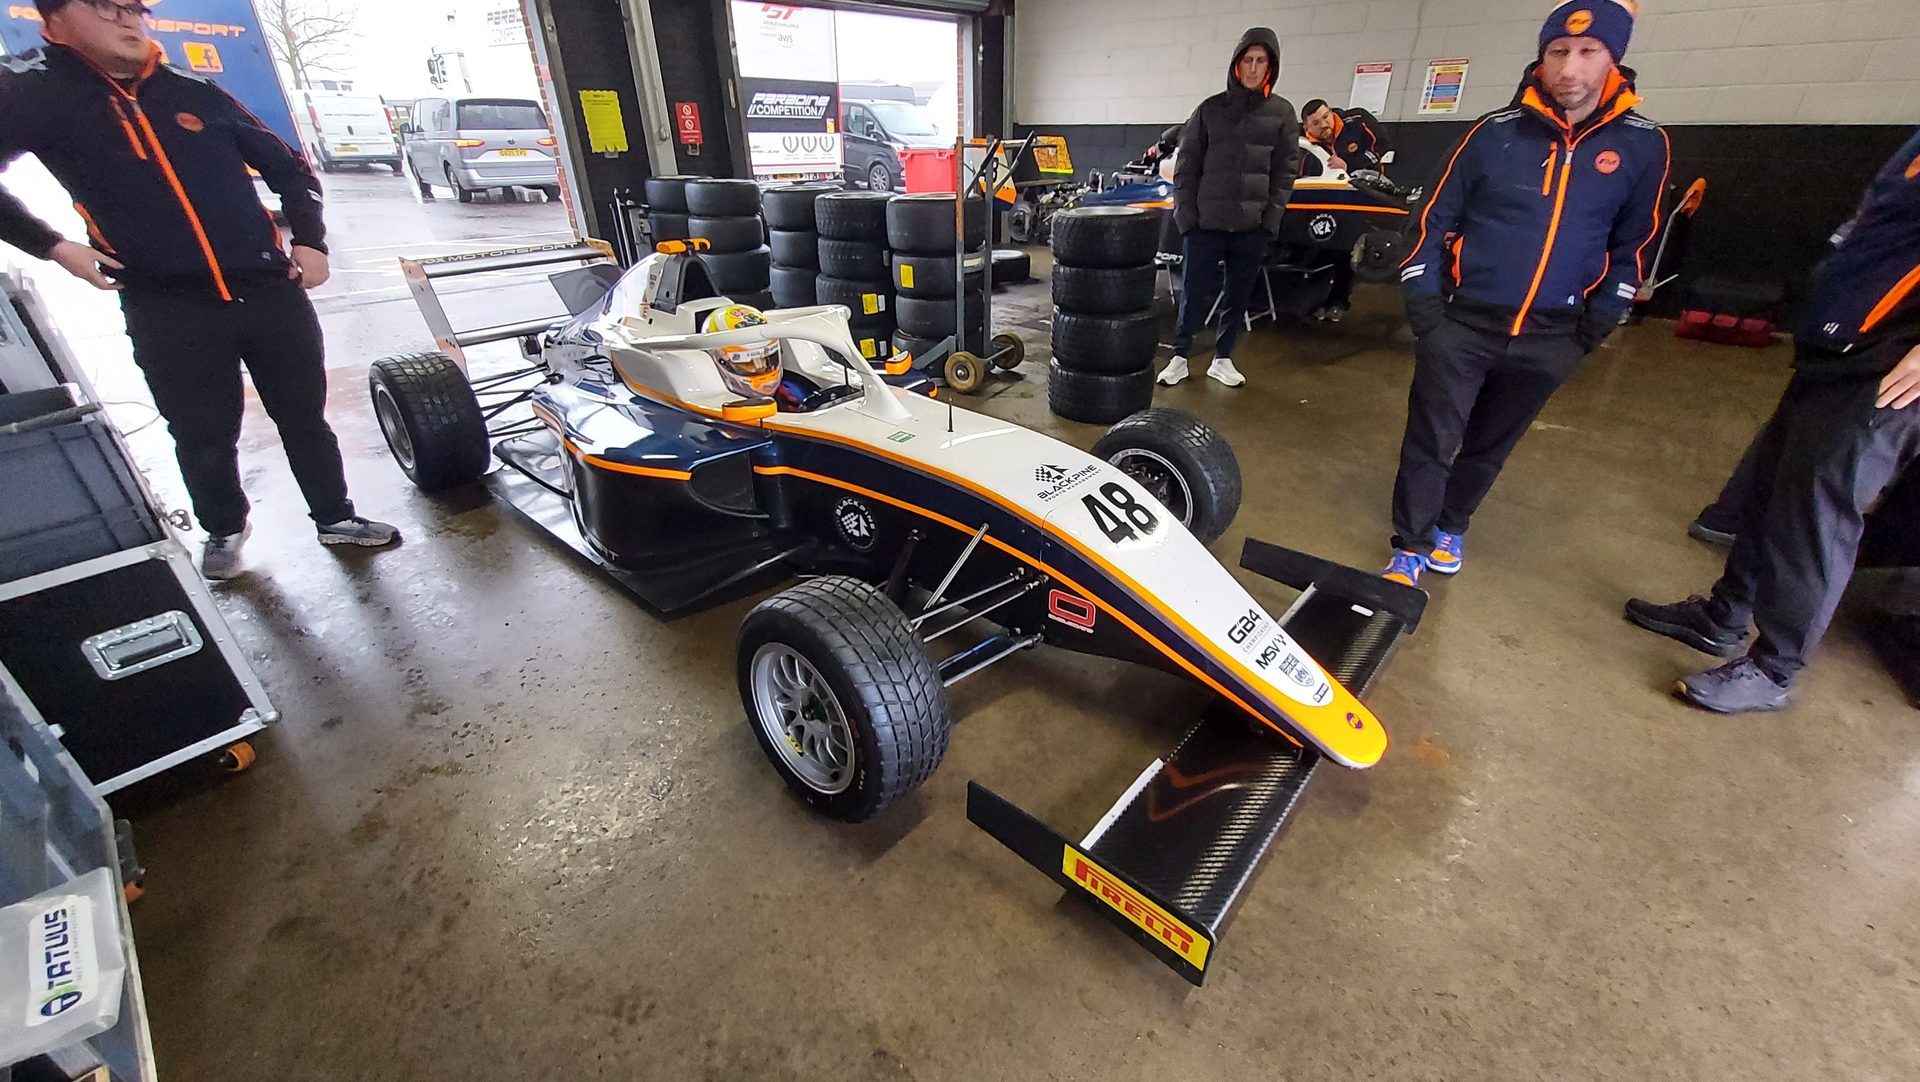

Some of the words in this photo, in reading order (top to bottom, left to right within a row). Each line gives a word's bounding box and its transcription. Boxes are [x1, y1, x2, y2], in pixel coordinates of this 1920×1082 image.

[448, 242, 579, 263] MOTORSPORT
[1037, 464, 1098, 500] BLACKPINE
[835, 498, 877, 531] BLACKPINE
[1081, 481, 1160, 544] 48
[1227, 608, 1263, 645] GB4
[1255, 640, 1281, 671] MSV
[1075, 857, 1195, 955] PIRELLI
